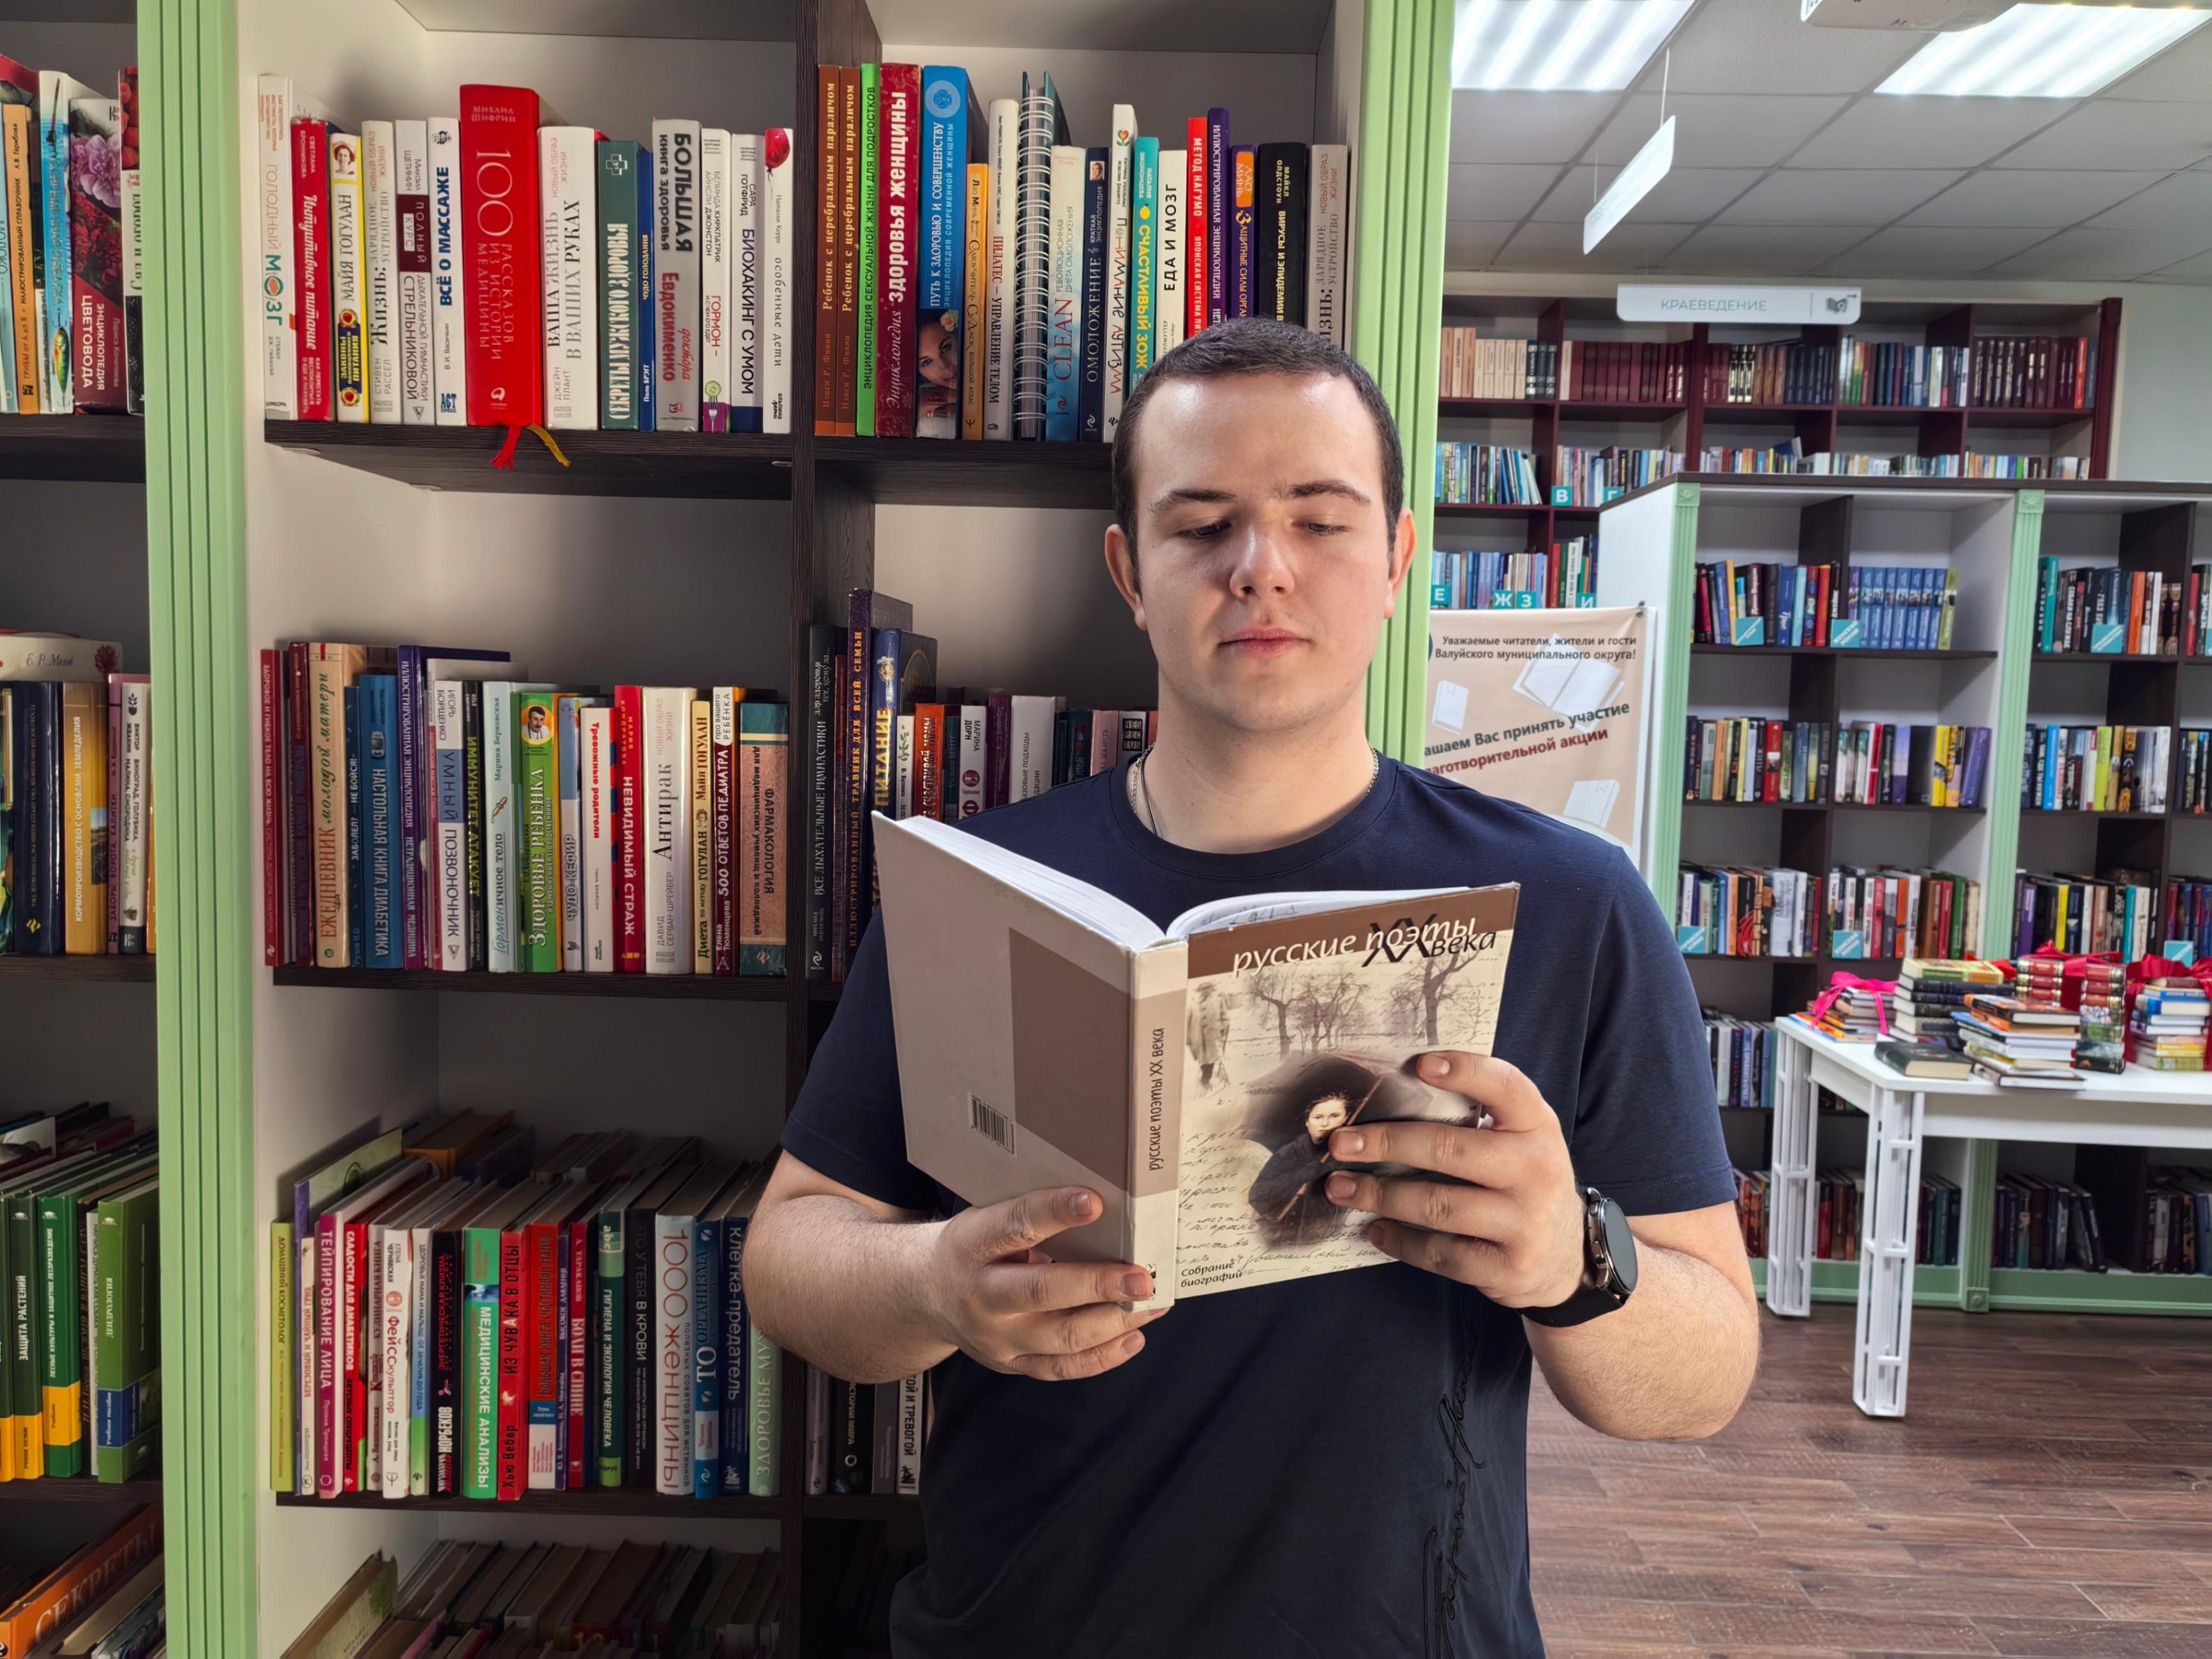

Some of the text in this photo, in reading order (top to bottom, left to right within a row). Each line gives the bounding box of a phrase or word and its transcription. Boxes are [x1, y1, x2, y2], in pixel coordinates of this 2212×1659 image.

[867, 87, 875, 157] ПОДРОСТКОВ
[266, 165, 278, 250] ГОЛОДНЫЙ
[476, 149, 513, 236] 100
[674, 133, 693, 252] БОЛЬШАЯ
[1193, 138, 1203, 216] МЕТОД НАГУМО
[16, 226, 26, 304] ИЛЛЮСТРИРОВАННЫЙ
[299, 195, 318, 283] Интуитивное
[338, 194, 354, 302] МАЙЯ ГОГУЛАН
[416, 202, 427, 264] ПОЛНЫЙ
[865, 226, 873, 301] СЕКСУАЛЬНОЙ
[887, 91, 907, 409] Энциклопедия здоровья женщины
[1055, 218, 1064, 292] РЕВОЛЮЦИОННАЯ
[1164, 184, 1177, 291] ЕДА И МОЗГ
[489, 243, 502, 360] ИЗ ИСТОРИИ
[501, 243, 515, 343] РАССКАЗОВ
[545, 212, 560, 347] ВАША ЖИЗНЬ
[564, 200, 581, 360] В ВАШИХ РУКАХ
[741, 229, 755, 394] БИОХАКИНГ С УМОМ
[1137, 225, 1149, 329] СЧАСТЛИВЫЙ
[1660, 299, 1768, 312] КРАЕВЕДЕНИЕ
[82, 295, 93, 388] ЦВЕТОВОДА
[305, 285, 317, 350] питание
[403, 276, 418, 400] СТРЕЛЬНИКОВОЙ
[711, 296, 721, 349] ГОРМОН
[864, 304, 873, 389] ЭНЦИКЛОПЕДИЯ
[1052, 297, 1072, 382] CLEAN
[1087, 257, 1102, 382] ОМОЛОЖЕНИЕ
[1136, 333, 1148, 369] ЗОЖ
[1556, 489, 1568, 503] В
[1434, 589, 1445, 601] Е
[1494, 593, 1512, 606] Ж
[1521, 595, 1531, 606] З
[1581, 596, 1593, 608] И
[1435, 649, 1636, 661] Валуйского муниципального округа!
[1442, 636, 1500, 646] Уважаемые
[1503, 636, 1551, 646] читатели,
[1554, 637, 1595, 646] жители
[1607, 637, 1637, 645] гости
[438, 689, 446, 740] БОРЩЕНКО
[1424, 702, 1630, 756] ашаем Вас принять участие
[1560, 728, 1609, 749] акции
[442, 752, 455, 820] УМНЫЙ
[467, 737, 479, 827] ИММУНИТЕТ
[695, 717, 707, 800] Майя ГОГУЛАН
[875, 706, 892, 807] ПИТАНИЕ
[652, 763, 679, 861] Антирак
[718, 749, 728, 896] 500 ОТВЕТОВ ПЕДИАТРА
[765, 788, 774, 894] ФАРМАКОЛОГИЯ
[814, 721, 827, 896] ВСЕ ДЫХАТЕЛЬНЫЕ ГИМНАСТИКИ
[75, 828, 84, 922] КОРМОПРОИЗВОДСТВО
[372, 769, 389, 956] НАСТОЛЬНАЯ КНИГА ДИАБЕТИКА
[445, 829, 460, 938] ПОЗВОНОЧНИК
[468, 831, 480, 896] АТАКУЕТ
[622, 776, 635, 935] НЕВИДИМЫЙ СТРАЖ
[1233, 917, 1477, 977] русские поэты
[1431, 931, 1497, 957] века
[1151, 1028, 1164, 1057] века
[1150, 1079, 1163, 1122] поэты
[1149, 1124, 1163, 1171] русские
[506, 1245, 520, 1282] ОТЦЫ
[1180, 1270, 1242, 1288] биографий
[1181, 1261, 1235, 1277] Собрание
[17, 1275, 29, 1361] ЗАЩИТА РАСТЕНИЙ
[105, 1277, 114, 1338] ДЕНДРОЛОГИЯ
[320, 1231, 333, 1388] ТЕЙПИРОВАНИЕ ЛИЦА
[504, 1301, 518, 1352] ЧУВАКА
[604, 1289, 613, 1332] ГИГИЕНА
[696, 1251, 717, 1383] ТО ОРГАНИЗМА
[478, 1306, 492, 1489] МЕДИЦИНСКИЕ АНАЛИЗЫ
[504, 1357, 516, 1374] ИЗ
[603, 1344, 612, 1394] ЭКОЛОГИЯ
[663, 1229, 688, 1488] 1000 женщины
[438, 1407, 453, 1453] НОРБЕКОВ
[502, 1425, 515, 1487] Хью Вебер
[603, 1397, 612, 1447] ЧЕЛОВЕКА
[756, 1377, 771, 1476] ЗДОРОВЬЕ
